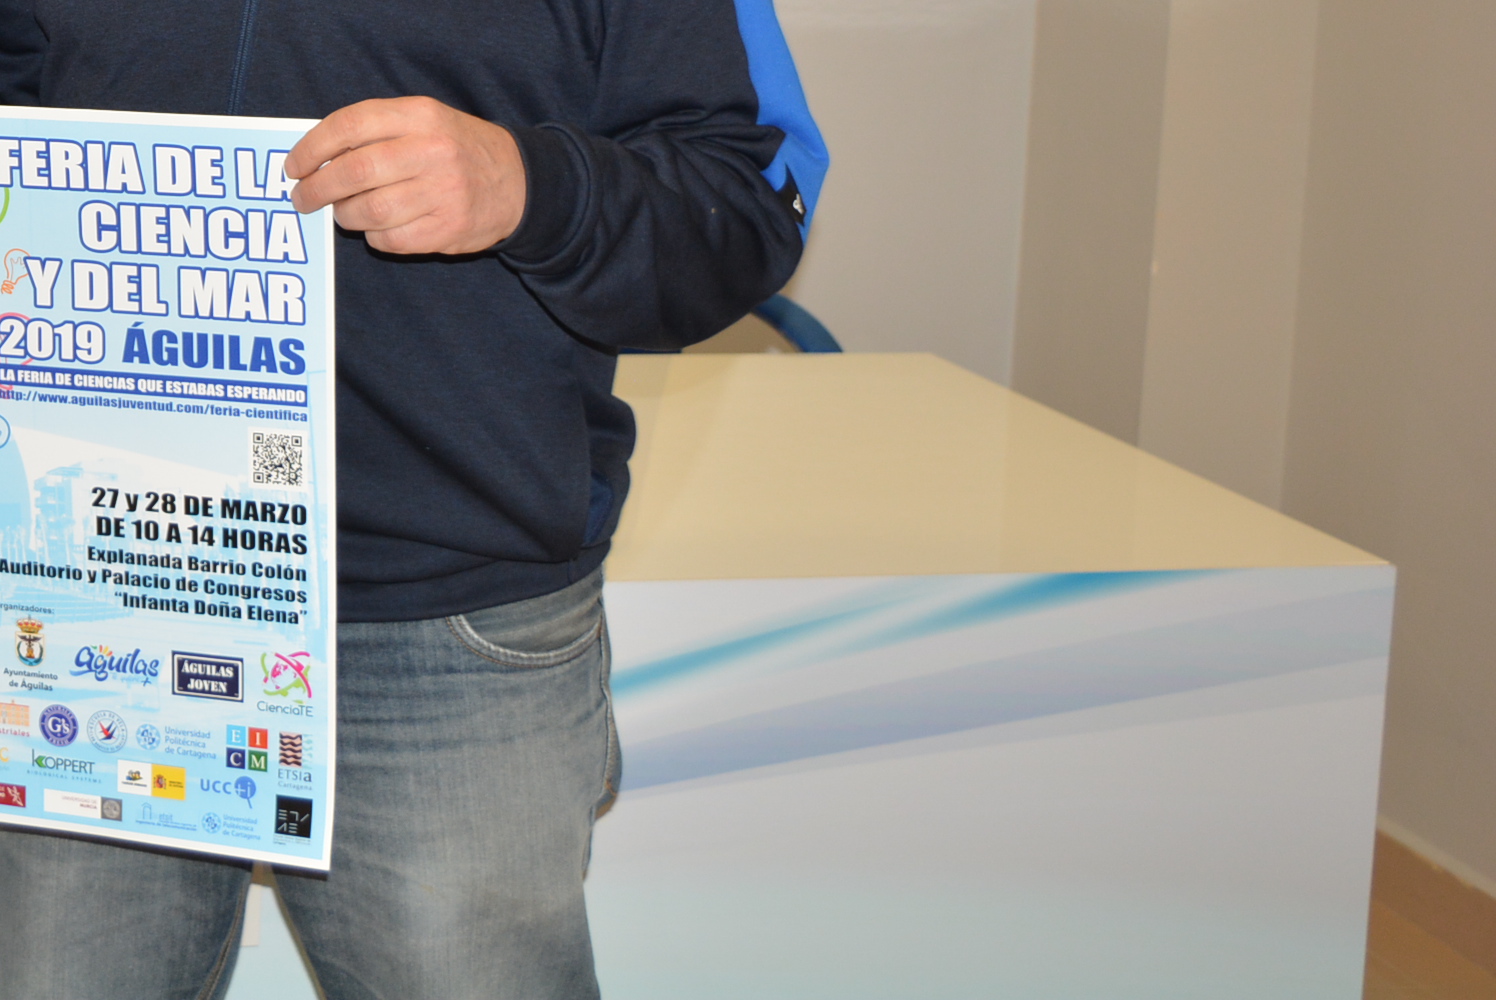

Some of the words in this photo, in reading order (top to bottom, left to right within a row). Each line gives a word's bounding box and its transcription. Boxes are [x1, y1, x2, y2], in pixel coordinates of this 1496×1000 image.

[153, 143, 226, 197] DE
[78, 200, 308, 264] CIENCIA
[23, 257, 62, 309] Y
[71, 259, 168, 316] DEL
[178, 266, 306, 325] MAR
[122, 322, 306, 375] ÁGUILAS
[0, 369, 15, 381] LA
[18, 370, 53, 384] FERIA
[55, 373, 71, 386] DE
[74, 374, 135, 390] CIENCIAS
[137, 378, 164, 393] QUE
[166, 381, 224, 397] ESTABAS
[227, 385, 305, 403] ESPERANDO
[92, 487, 119, 508] 27
[125, 493, 138, 512] y
[145, 492, 176, 513] 28
[184, 495, 213, 517] DE
[221, 498, 307, 526] MARZO
[96, 516, 125, 538] DE
[131, 519, 158, 541] 10
[166, 523, 181, 543] A
[187, 525, 215, 547] 14
[222, 528, 308, 555] HORAS
[87, 545, 182, 569] Explanada
[188, 556, 246, 575] Barrio
[252, 562, 307, 582] Colón
[87, 569, 96, 583] y
[102, 568, 170, 590] Palacio
[176, 576, 198, 592] de
[204, 579, 307, 603] Congresos
[114, 591, 189, 613] “Infanta
[194, 600, 242, 619] Doña
[247, 605, 307, 624] Elena”
[4, 668, 58, 680] Ayuntamiento
[9, 680, 18, 688] de
[20, 678, 53, 691] Águilas
[182, 660, 234, 678] ÁGUILAS
[187, 678, 227, 694] JOVEN
[257, 701, 314, 717] CienciaTE
[165, 726, 210, 739] Universidad
[165, 736, 206, 748] Politécnica
[177, 746, 216, 759] Cartagena
